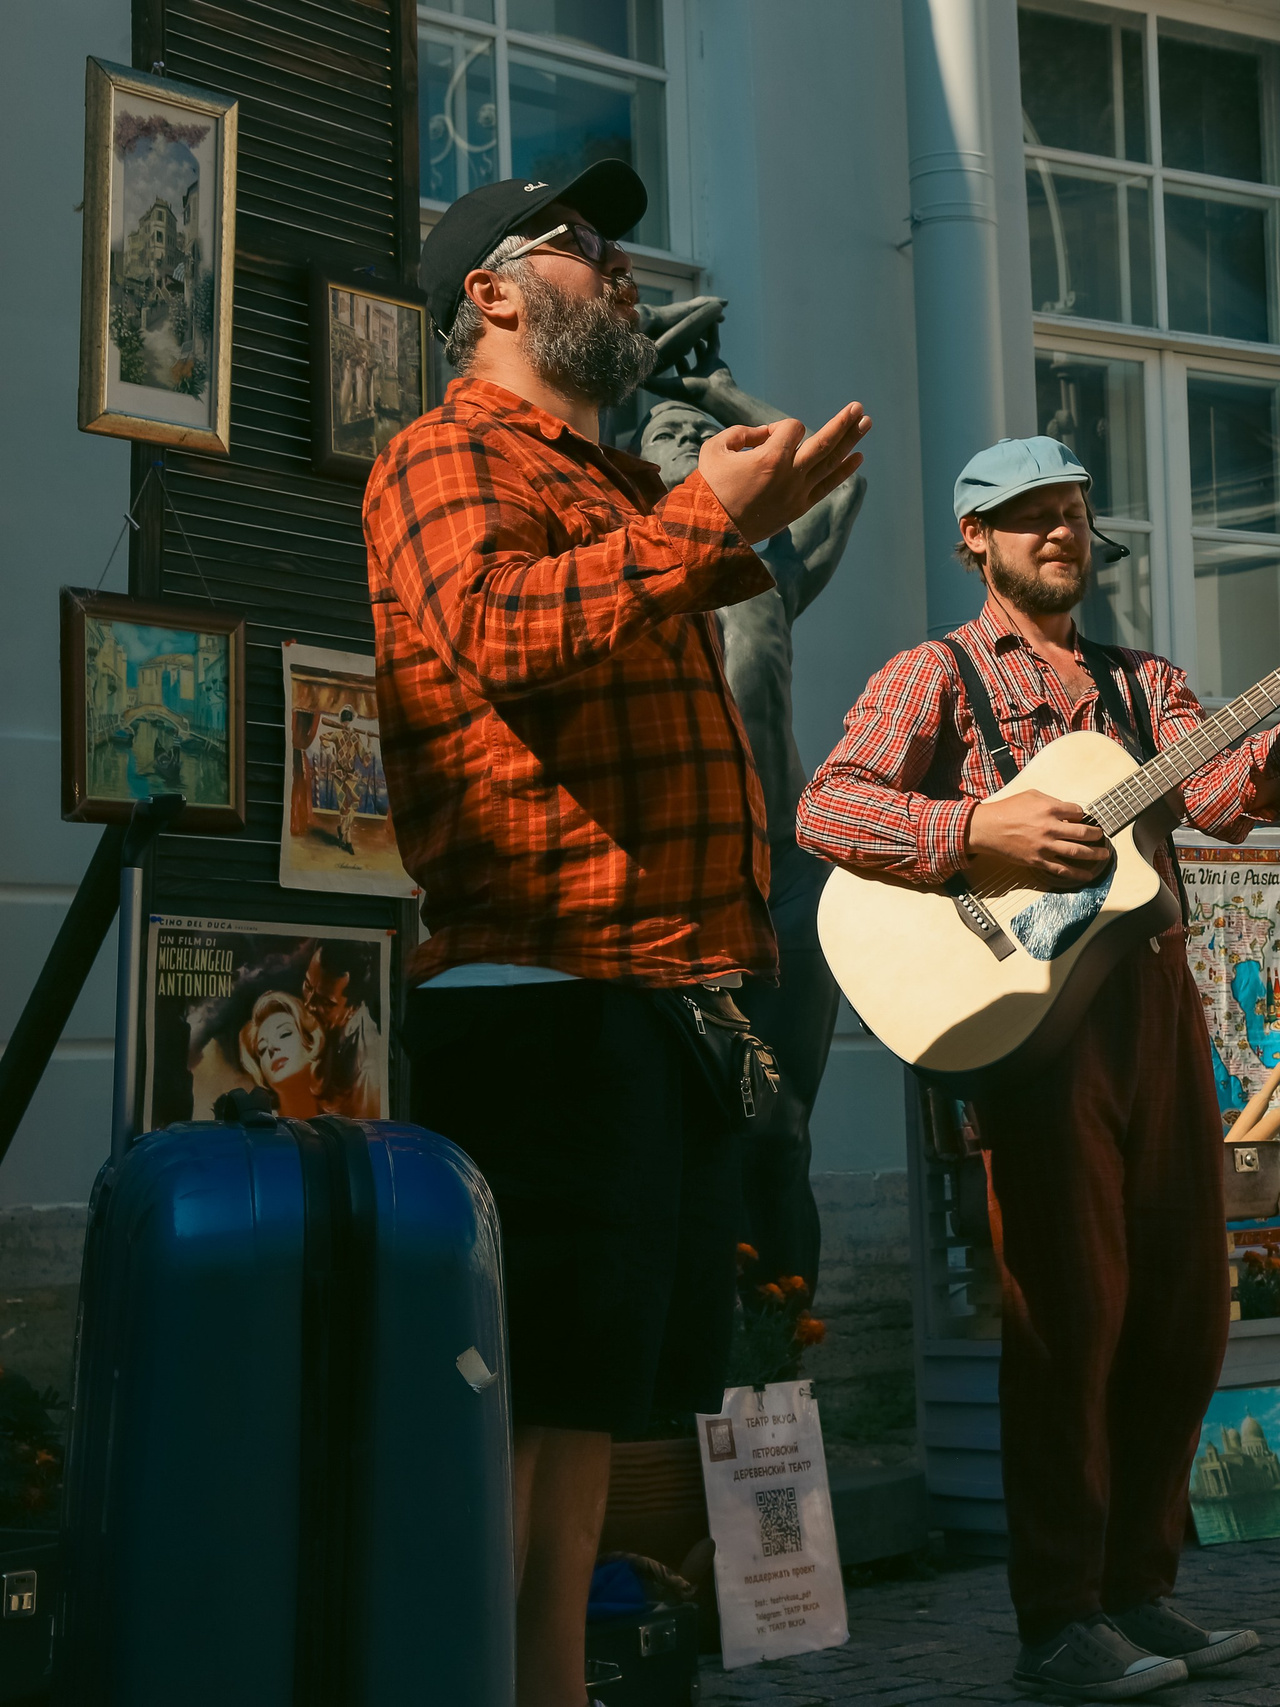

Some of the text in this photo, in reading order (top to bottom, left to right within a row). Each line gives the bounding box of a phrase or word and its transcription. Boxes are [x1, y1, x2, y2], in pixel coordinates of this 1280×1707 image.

[1182, 868, 1280, 885] lia Vini e Pasta
[186, 920, 203, 928] DEL
[207, 921, 233, 930] DUCA
[160, 935, 217, 947] UN FILM DI
[158, 946, 233, 973] MICHELANGELO
[158, 972, 232, 998] ANTONIONI
[745, 1413, 798, 1428] ТЕАТР ВКУСА
[752, 1441, 799, 1459] ПЕТРОВСКИЙ
[733, 1460, 812, 1482] ДЕРЕВЕНСКИЙ ТЕАТР
[744, 1565, 816, 1585] поддержать проект
[783, 1605, 801, 1616] ТЕАТР
[802, 1602, 821, 1612] ВКУСА
[768, 1621, 787, 1633] ТЕАТР
[787, 1617, 807, 1629] ВКУСА
